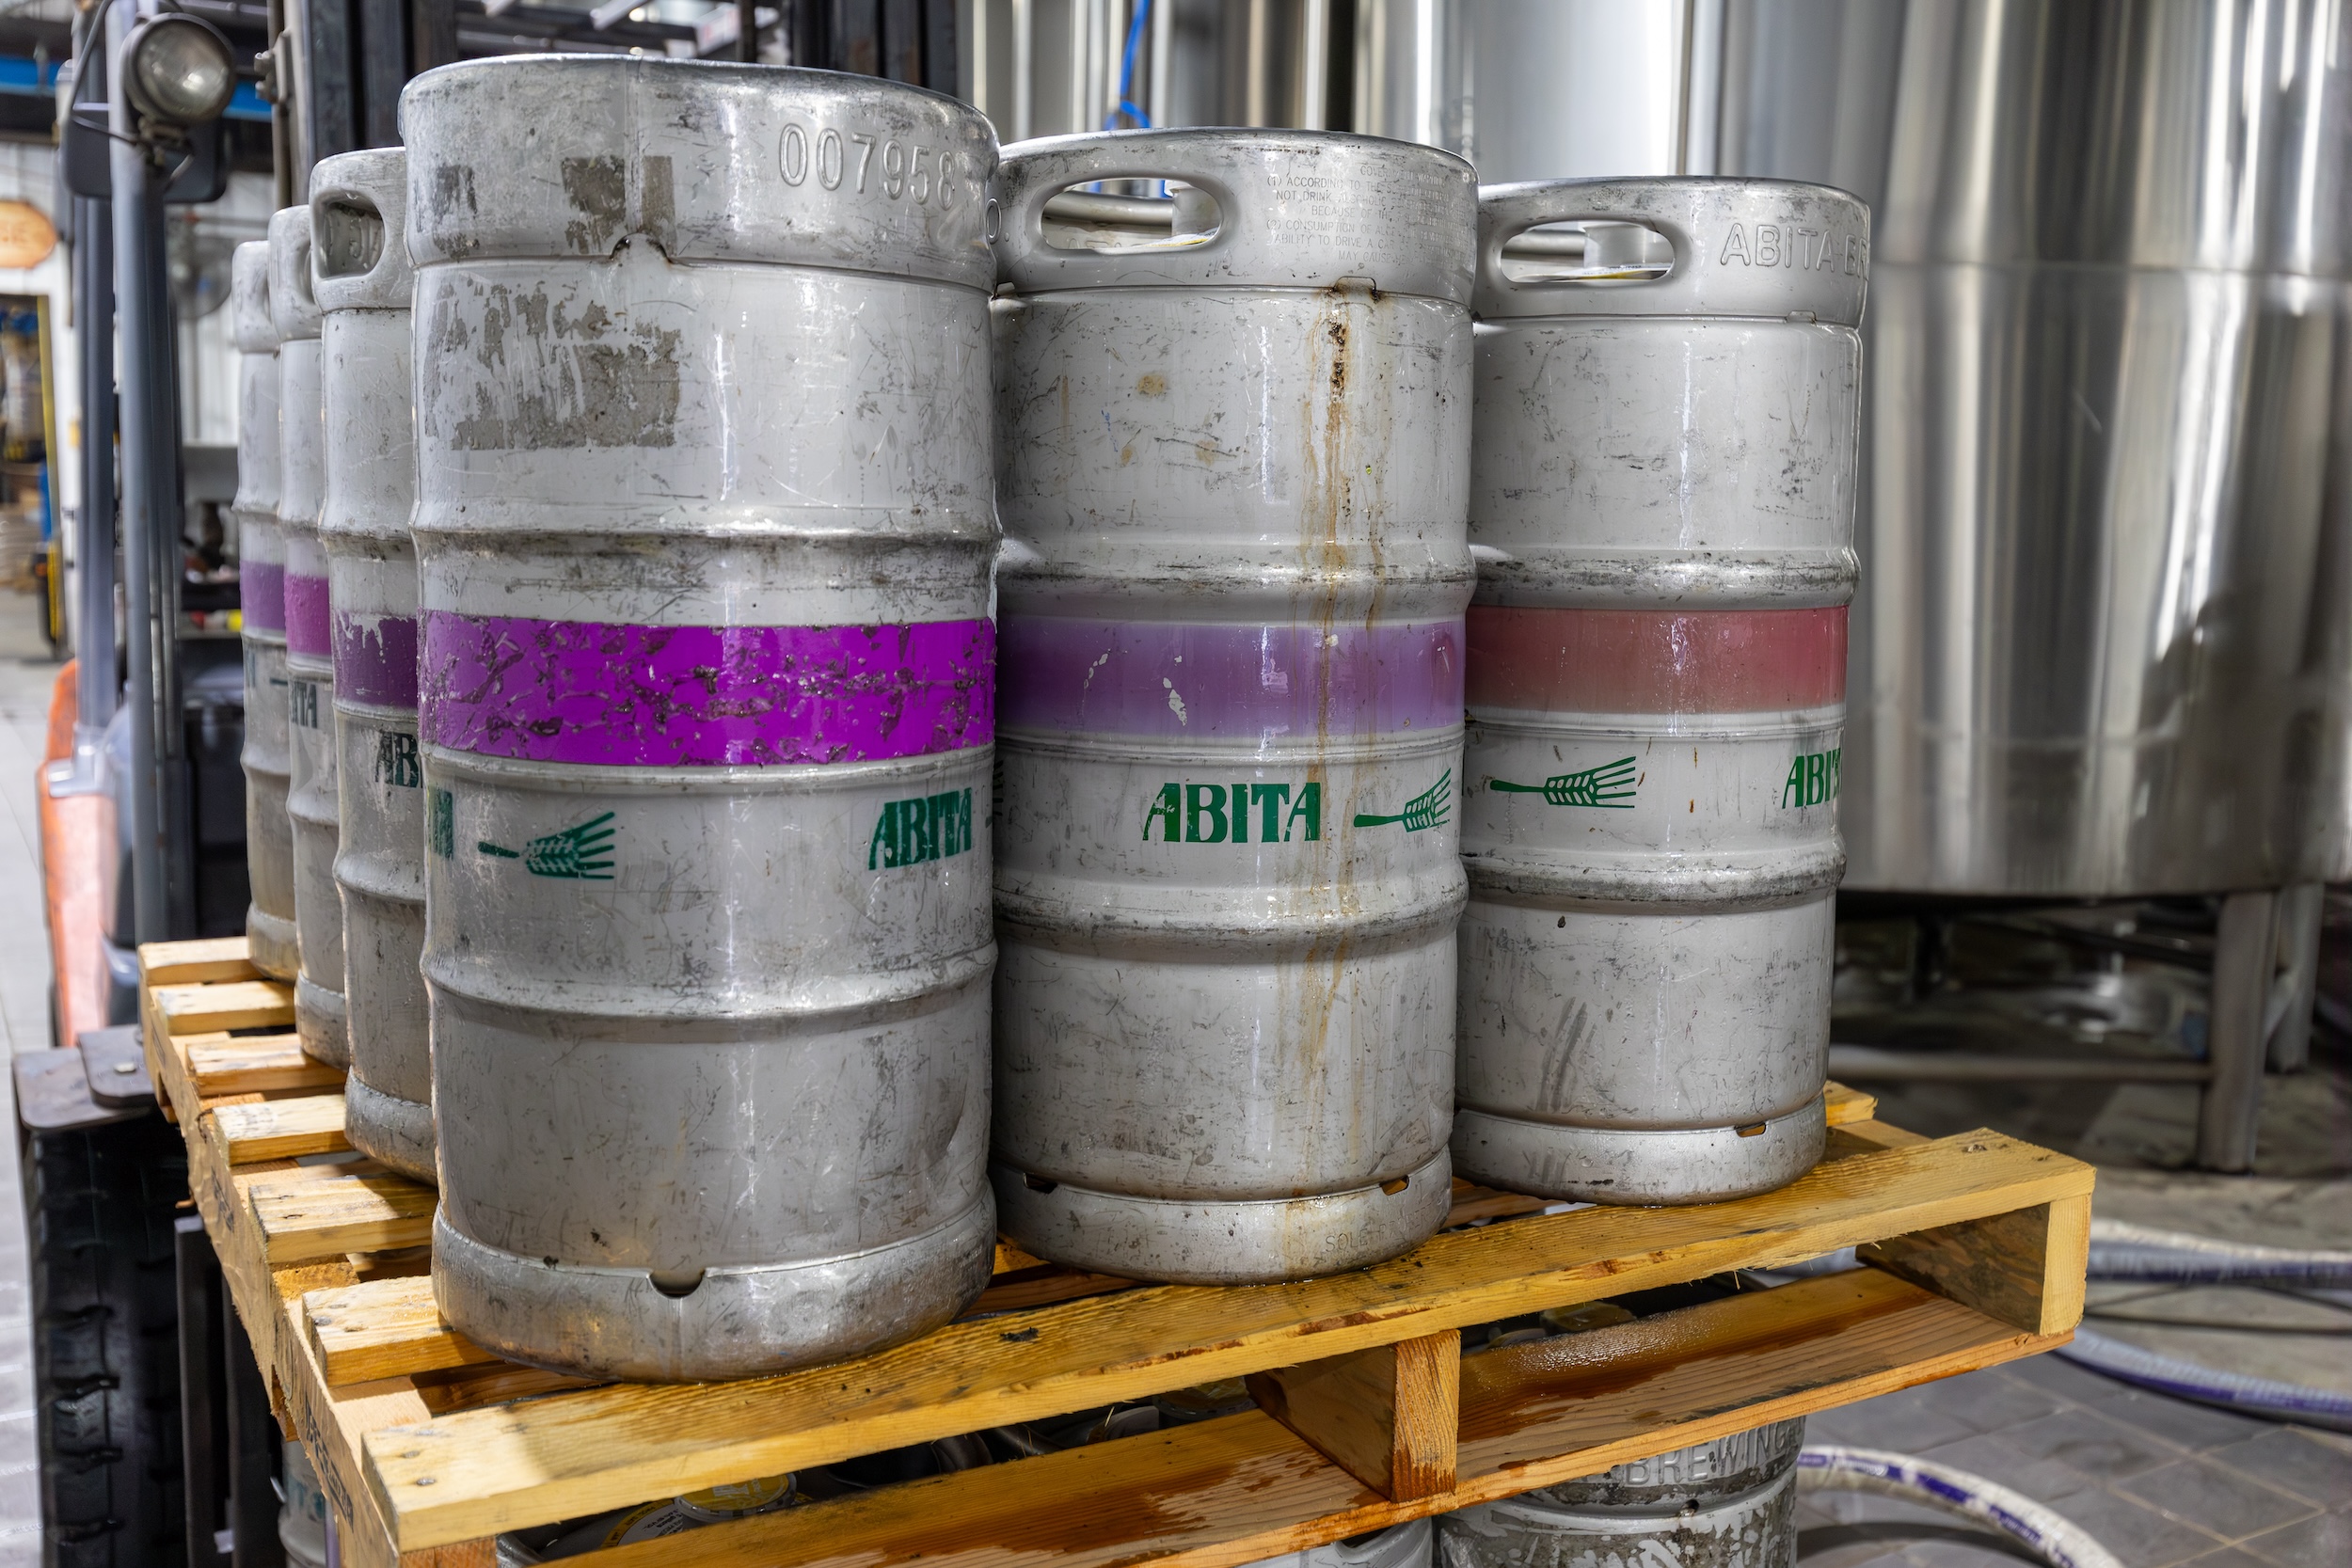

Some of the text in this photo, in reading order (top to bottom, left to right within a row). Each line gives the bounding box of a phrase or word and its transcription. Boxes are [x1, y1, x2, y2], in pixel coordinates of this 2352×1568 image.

[779, 122, 957, 211] 007958
[1287, 176, 1343, 189] ACCORDING
[1349, 180, 1360, 191] TO
[1366, 182, 1383, 194] THE
[1276, 190, 1297, 201] NOT
[1303, 191, 1332, 202] DRINK
[1311, 205, 1356, 218] BECAUSE
[1361, 208, 1373, 219] OF
[1286, 219, 1355, 233] CONSUMPTION
[1361, 224, 1373, 234] OF
[1275, 234, 1312, 245] ABILITY
[1318, 235, 1330, 245] TO
[1336, 236, 1361, 247] DRIVE
[1367, 238, 1374, 248] A
[1720, 222, 1836, 273] ABITA
[1338, 250, 1359, 261] MAY
[1363, 251, 1392, 263] CAUSE
[1142, 782, 1321, 844] ABITA
[867, 787, 973, 871] ABITA
[1325, 1227, 1369, 1253] SOLE
